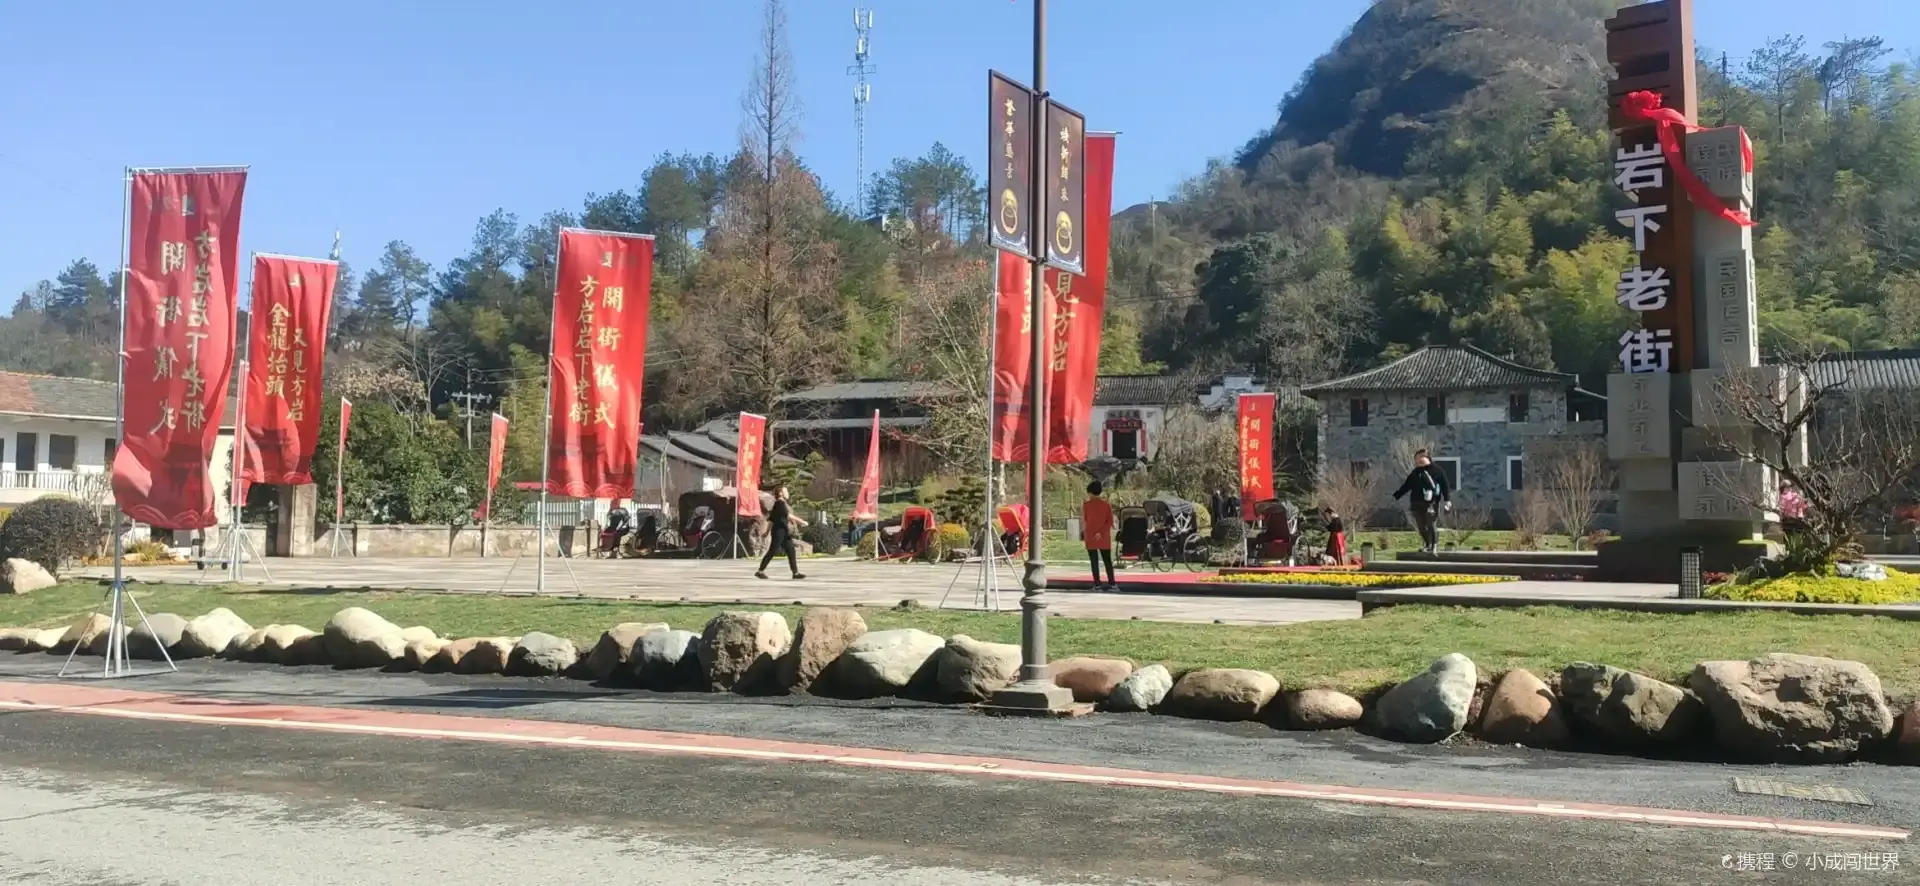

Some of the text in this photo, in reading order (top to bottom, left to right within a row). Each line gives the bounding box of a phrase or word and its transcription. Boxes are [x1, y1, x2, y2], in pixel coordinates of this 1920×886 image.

[1614, 143, 1673, 373] 岩下老街
[265, 302, 292, 399] 金龍抬頭
[286, 328, 308, 422] 又見方岩
[568, 274, 599, 427] 方岩岩下老街
[593, 286, 624, 429] 開街儀式
